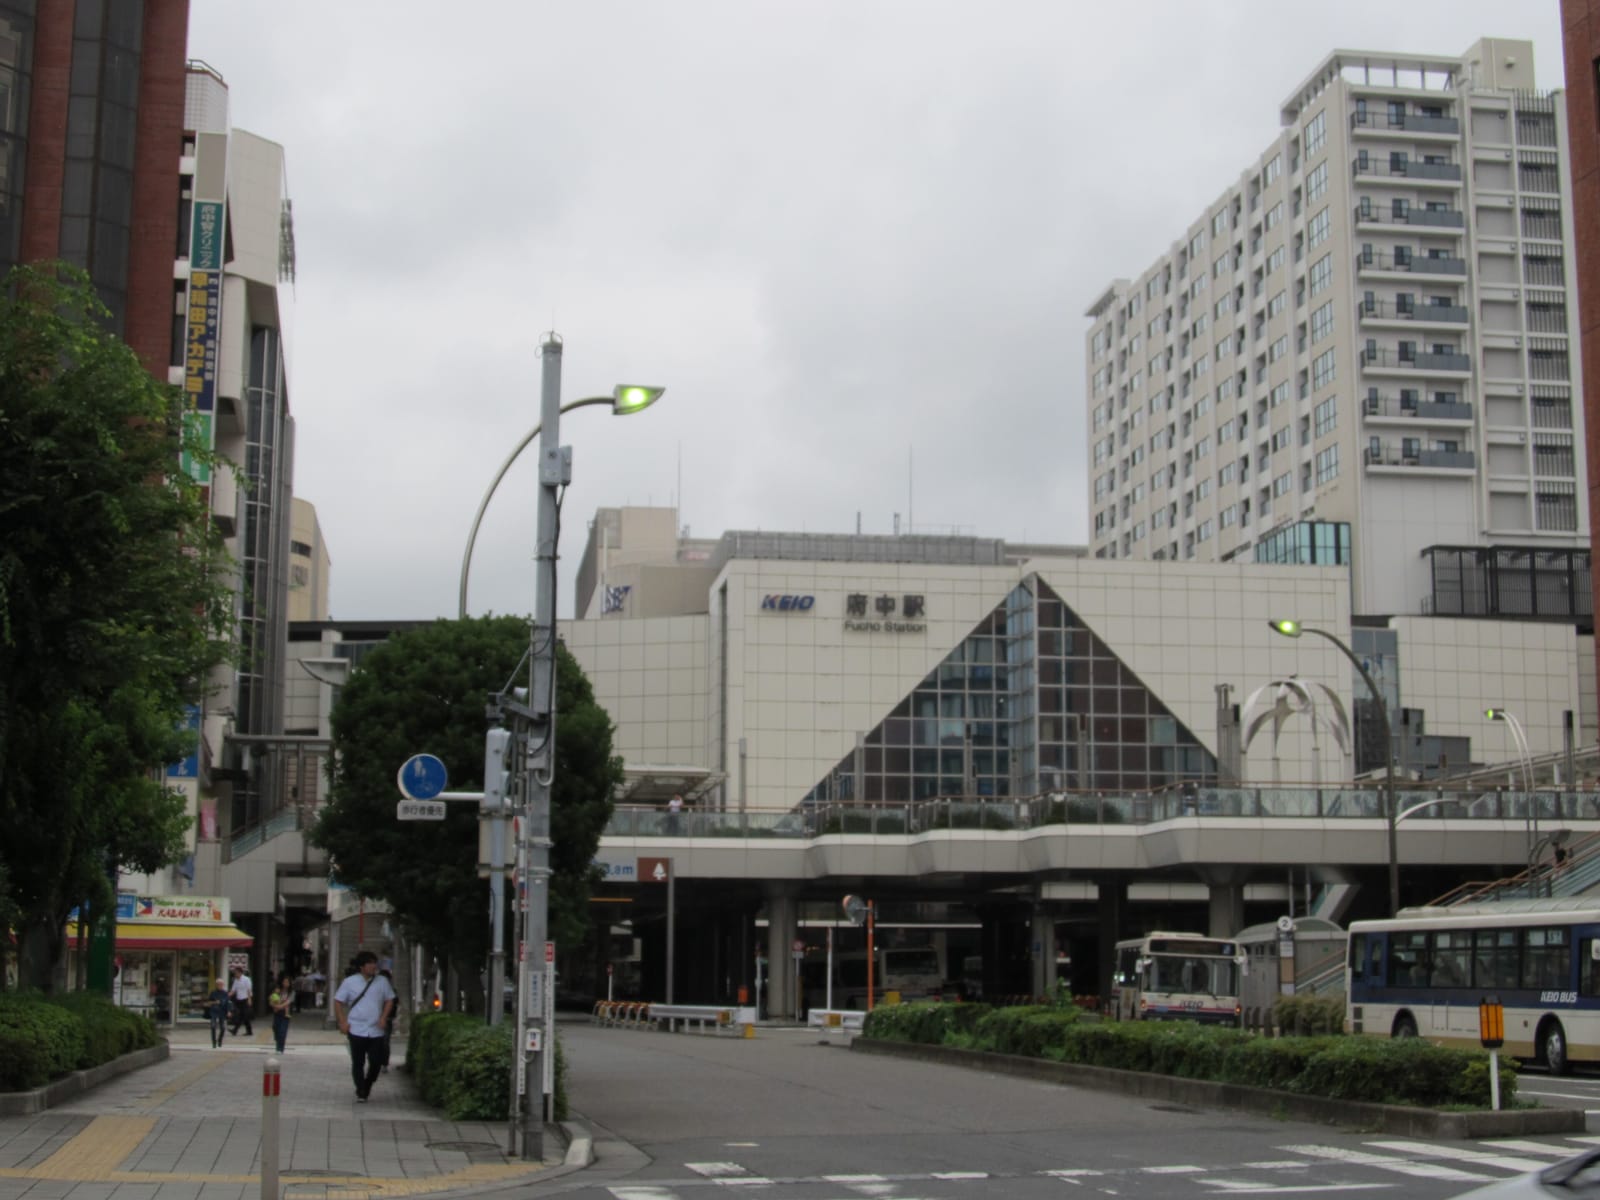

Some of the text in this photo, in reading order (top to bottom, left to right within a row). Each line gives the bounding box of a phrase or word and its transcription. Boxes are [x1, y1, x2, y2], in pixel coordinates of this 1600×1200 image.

[761, 594, 815, 611] KEIO
[846, 593, 925, 617] 府中駅
[884, 620, 928, 633] Station
[1560, 991, 1578, 1003] BUS
